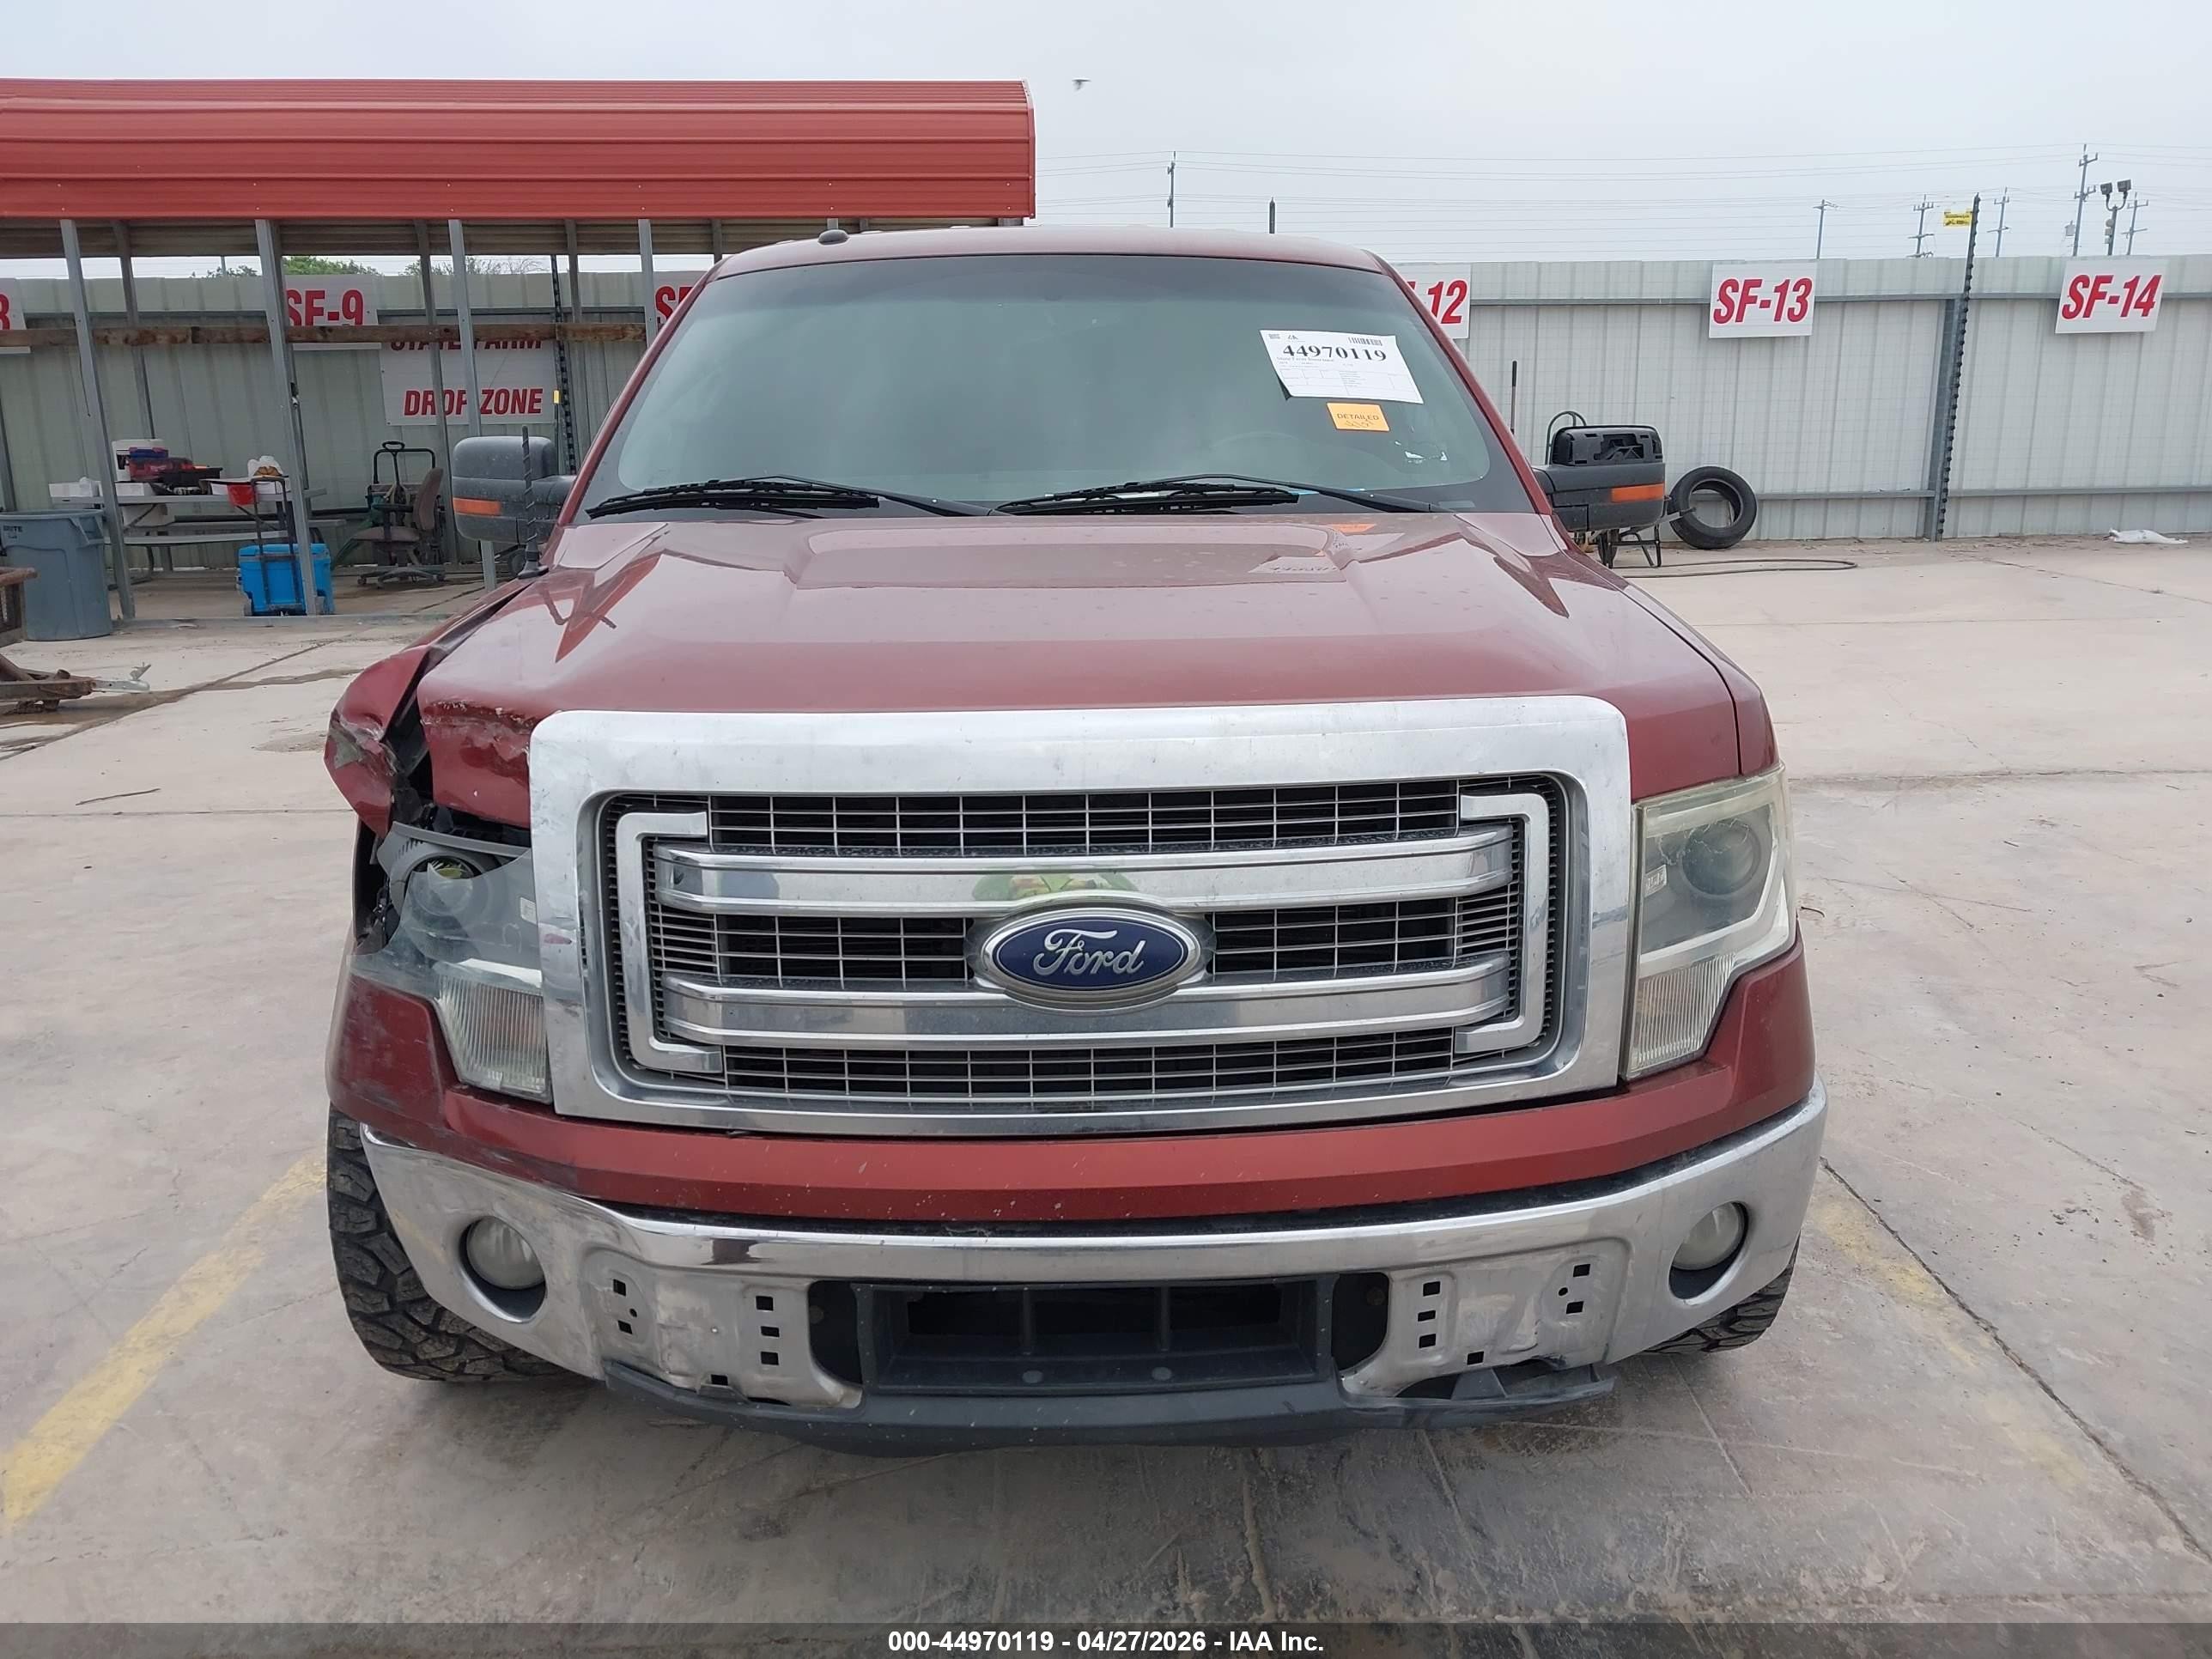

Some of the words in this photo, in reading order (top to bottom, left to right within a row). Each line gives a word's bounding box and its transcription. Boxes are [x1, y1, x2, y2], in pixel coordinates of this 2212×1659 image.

[286, 289, 364, 326] SF-9
[1713, 277, 1813, 325] SF-13
[2062, 274, 2162, 319] SF-14
[1282, 344, 1387, 362] 44970119
[479, 387, 544, 415] ZONE
[1032, 928, 1146, 975] Ford
